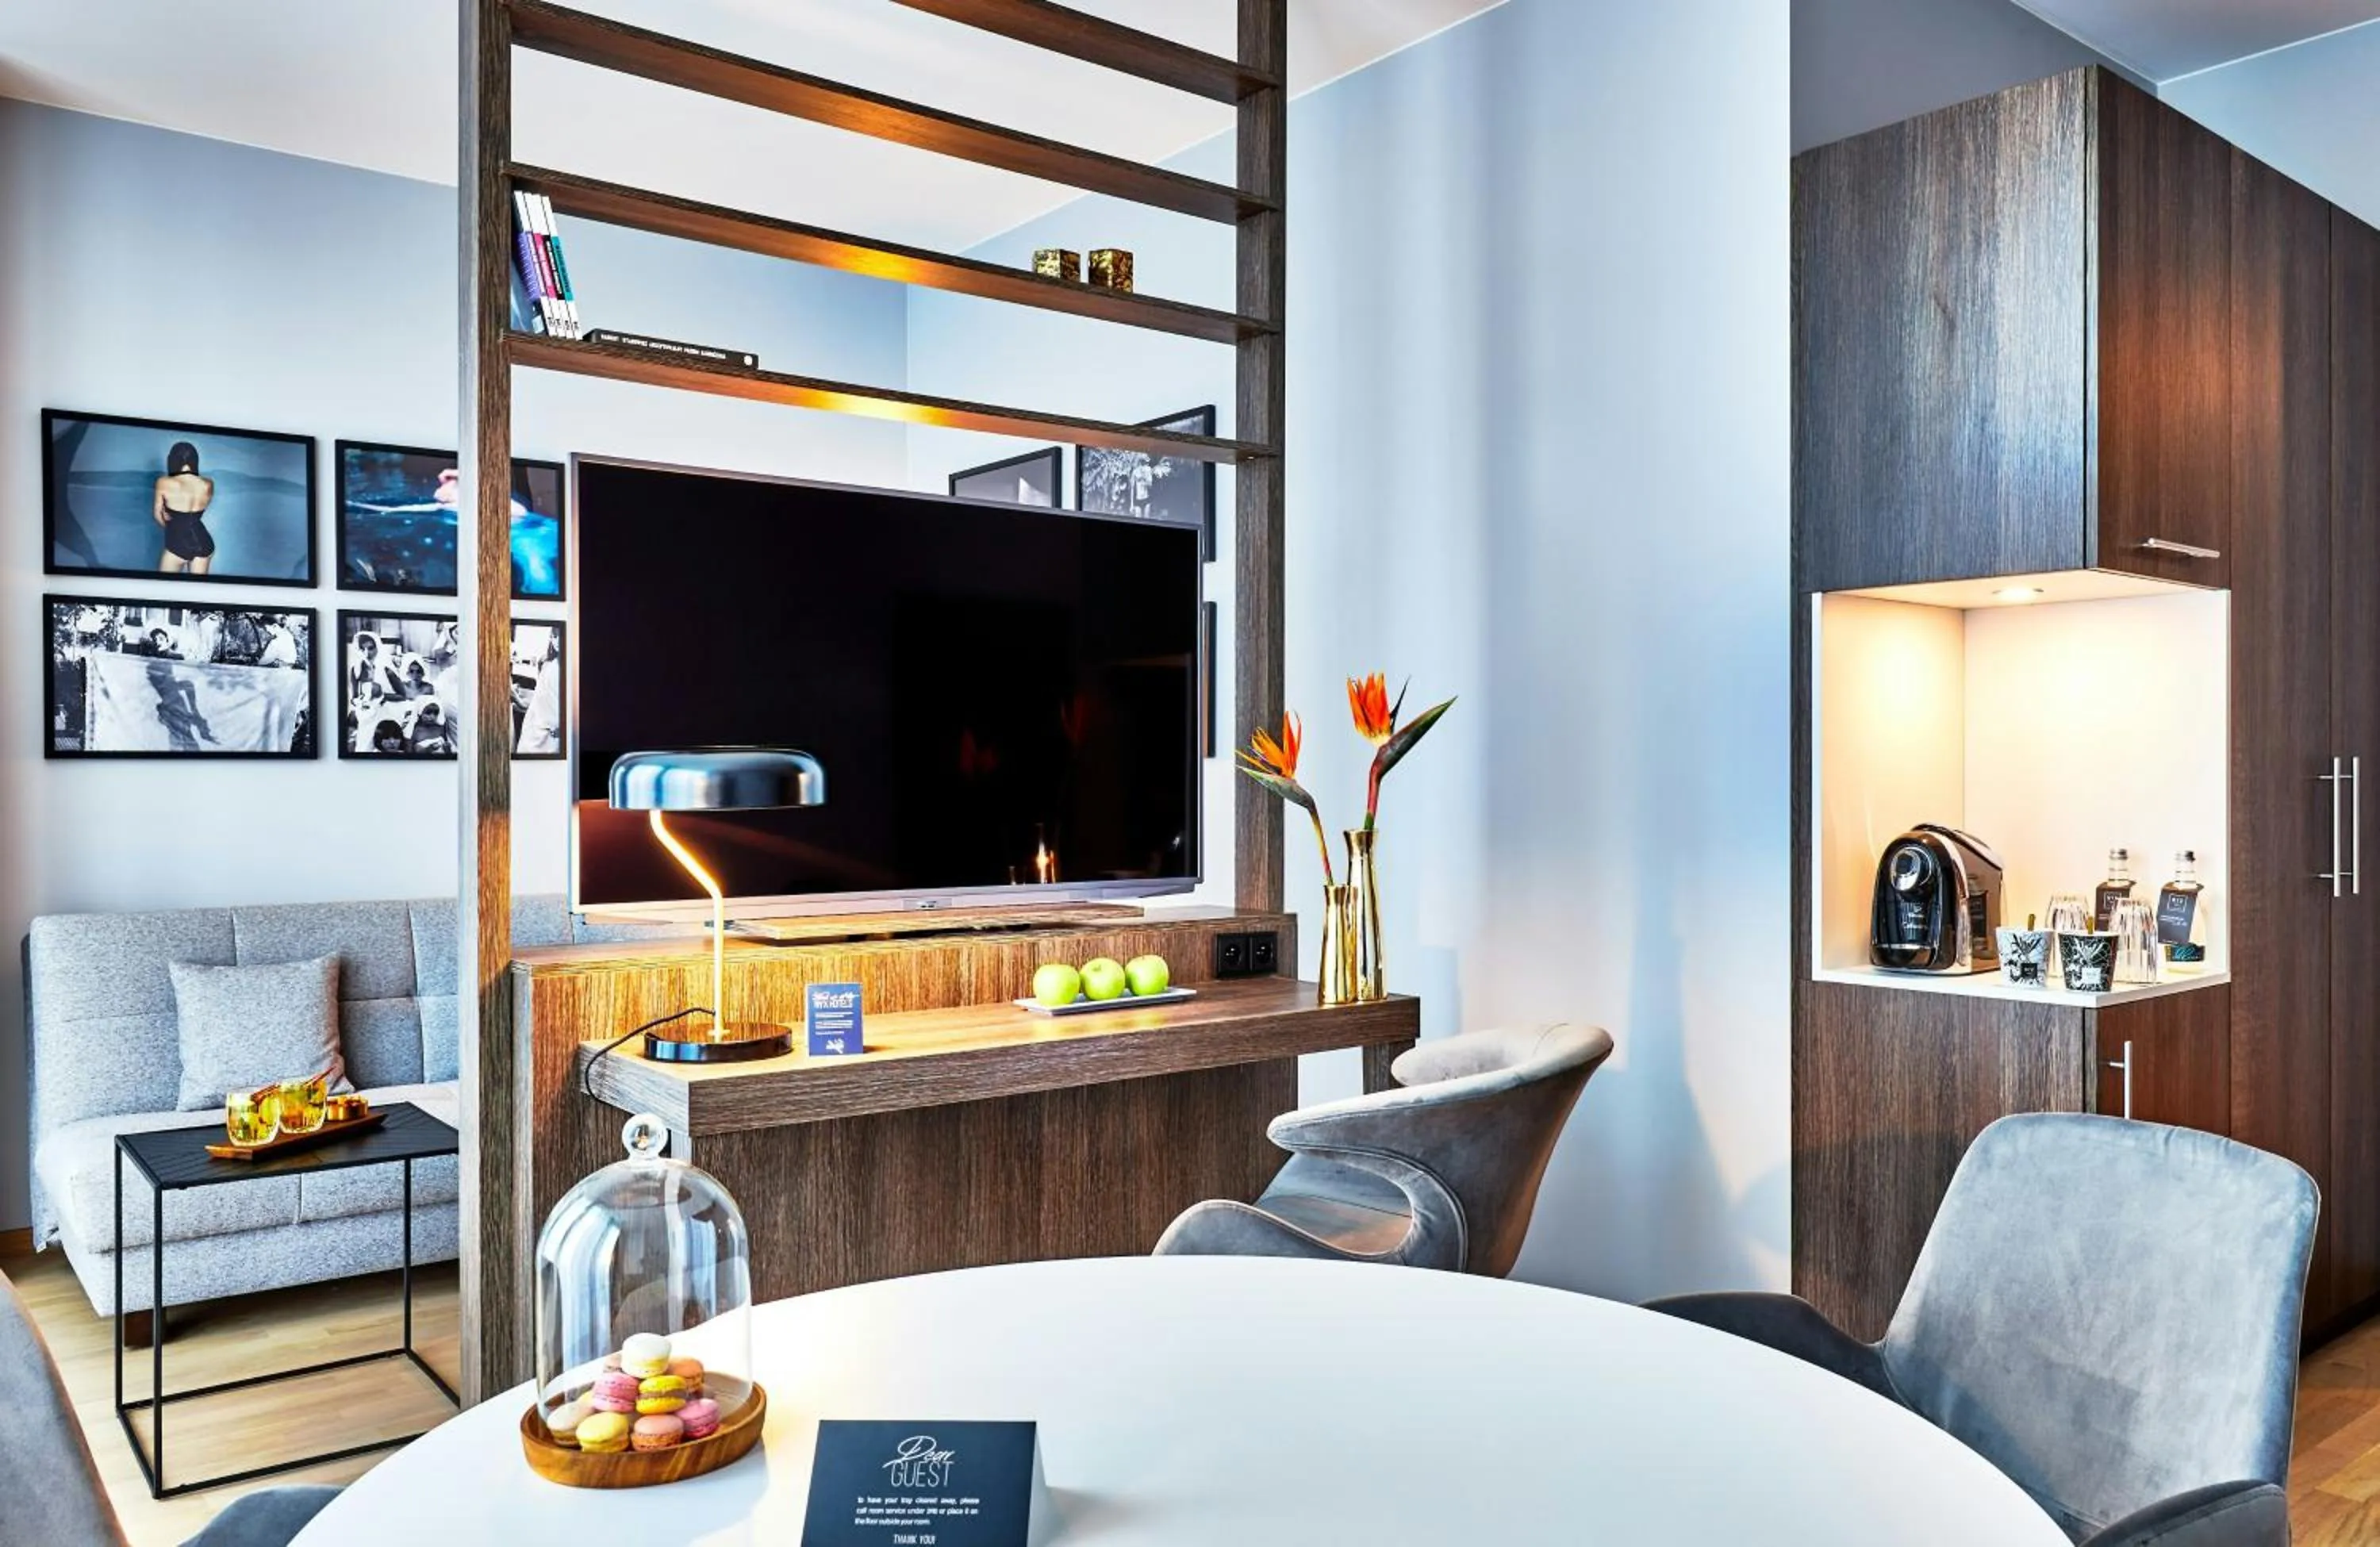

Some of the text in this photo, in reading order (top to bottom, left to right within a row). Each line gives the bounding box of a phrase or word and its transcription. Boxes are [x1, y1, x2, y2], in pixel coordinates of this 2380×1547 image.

[882, 1435, 955, 1468] Dear
[891, 1460, 954, 1488] GUEST
[946, 1507, 963, 1515] place
[893, 1534, 918, 1544] THANK
